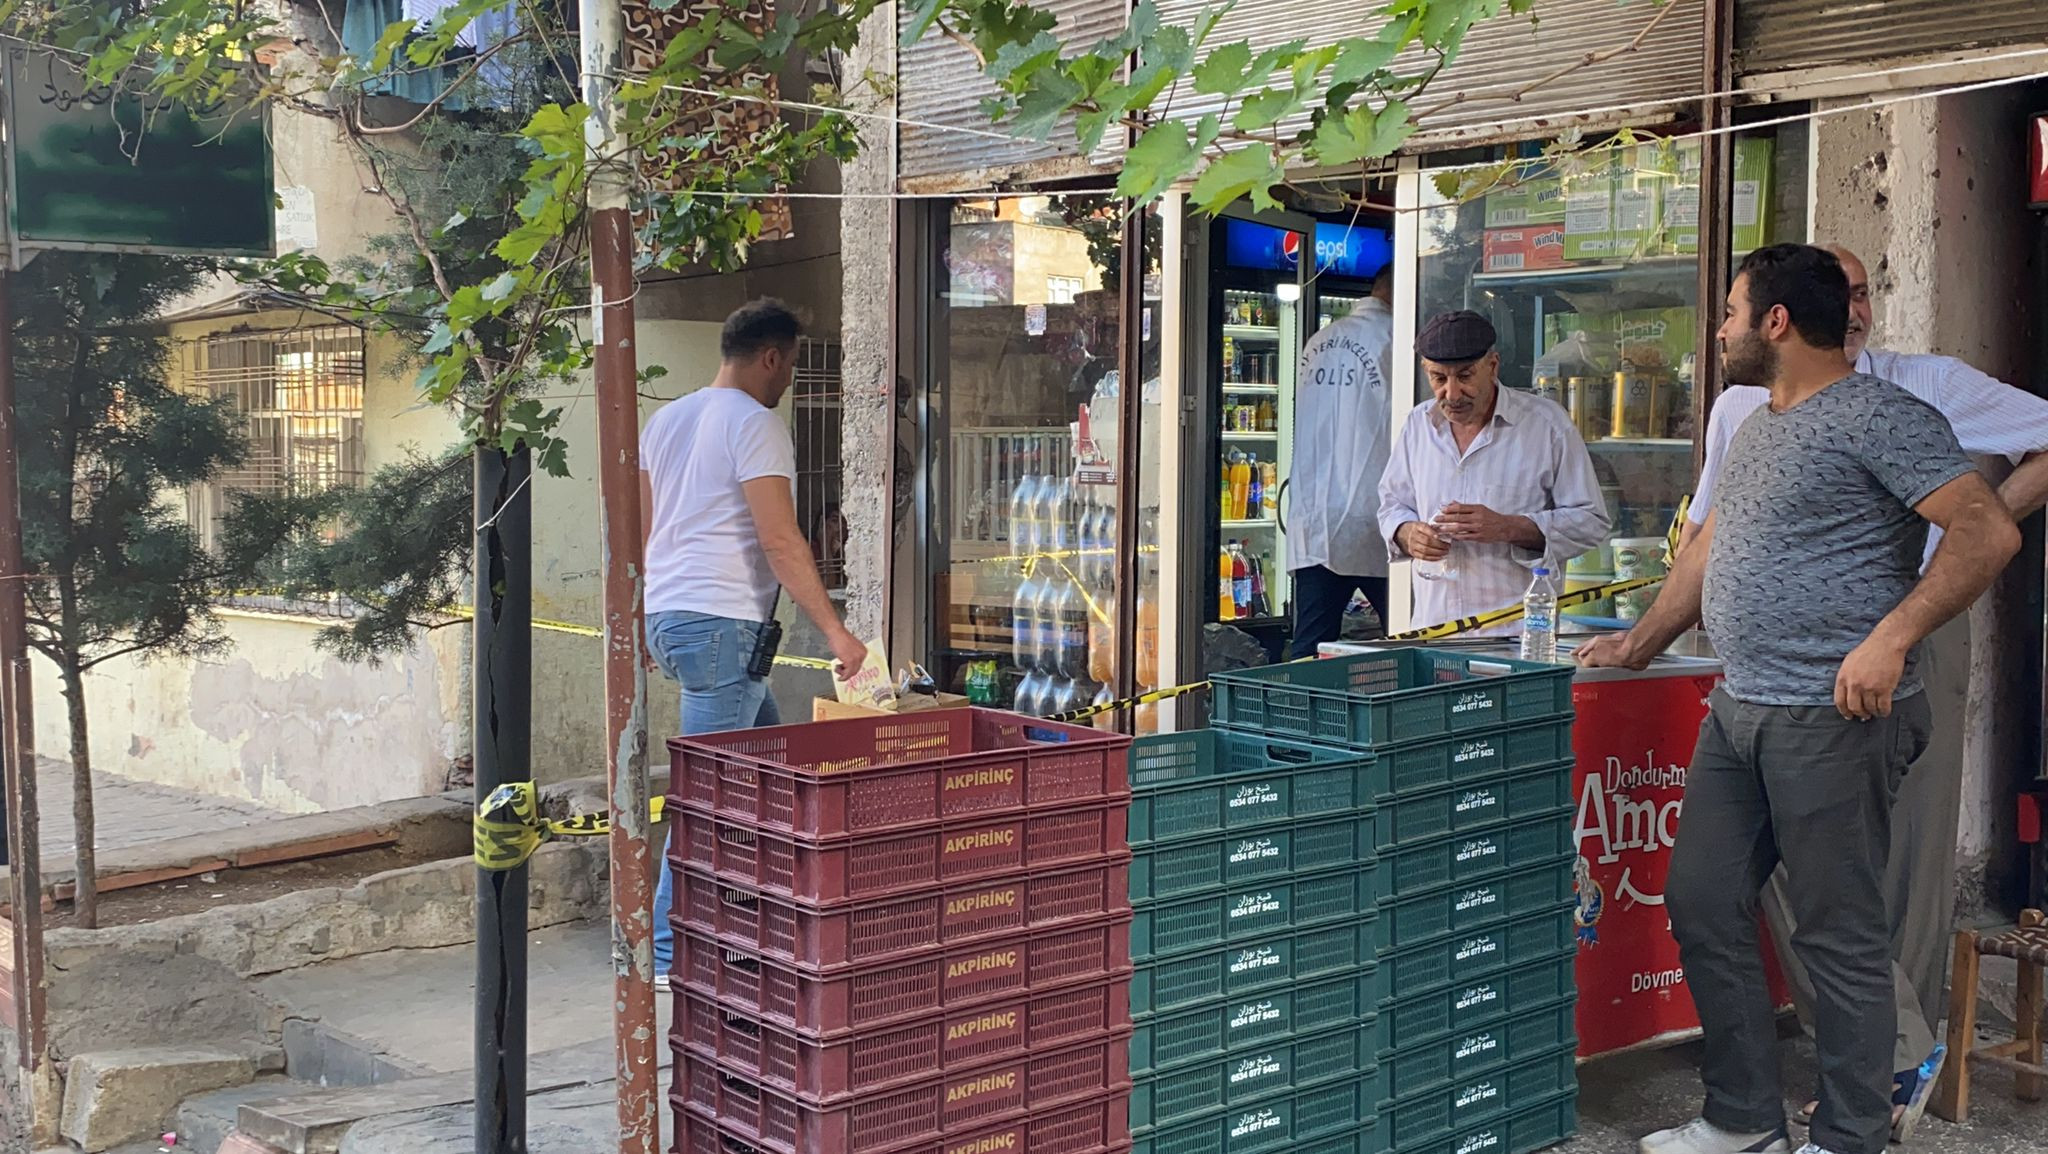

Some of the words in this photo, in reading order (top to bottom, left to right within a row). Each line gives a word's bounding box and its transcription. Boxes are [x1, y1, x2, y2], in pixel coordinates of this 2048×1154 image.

[1316, 240, 1347, 261] epsi
[945, 768, 1014, 791] AKPİRİNÇ
[1605, 749, 1688, 794] Dondurm
[1230, 798, 1246, 807] 0534
[1248, 796, 1259, 804] 077
[1261, 793, 1277, 802] 5432
[1573, 772, 1683, 864] Amc
[945, 829, 1014, 854] AKPİRİNÇ
[1230, 853, 1246, 862] 0534
[1248, 851, 1260, 859] 077
[1262, 848, 1278, 856] 5432
[946, 891, 1015, 915] AKPİRİNÇ
[1231, 908, 1247, 917] 0534
[1249, 904, 1261, 914] 077
[1262, 901, 1279, 911] 5432
[948, 951, 1016, 977] AKPİRİNÇ
[1231, 962, 1247, 972] 0534
[1249, 959, 1261, 968] 077
[1263, 955, 1279, 965] 5432
[1631, 967, 1684, 993] Dövme
[948, 1012, 1016, 1040] AKPİRİNÇ
[1231, 1017, 1247, 1028] 0534
[1249, 1013, 1261, 1023] 077
[1263, 1009, 1279, 1019] 5432
[1231, 1071, 1247, 1082] 0534
[1249, 1067, 1261, 1077] 077
[1263, 1063, 1279, 1073] 5432
[947, 1073, 1015, 1102] AKPİRİNÇ
[1232, 1126, 1248, 1137] 0534
[1250, 1122, 1261, 1131] 077
[1263, 1117, 1280, 1128] 5432
